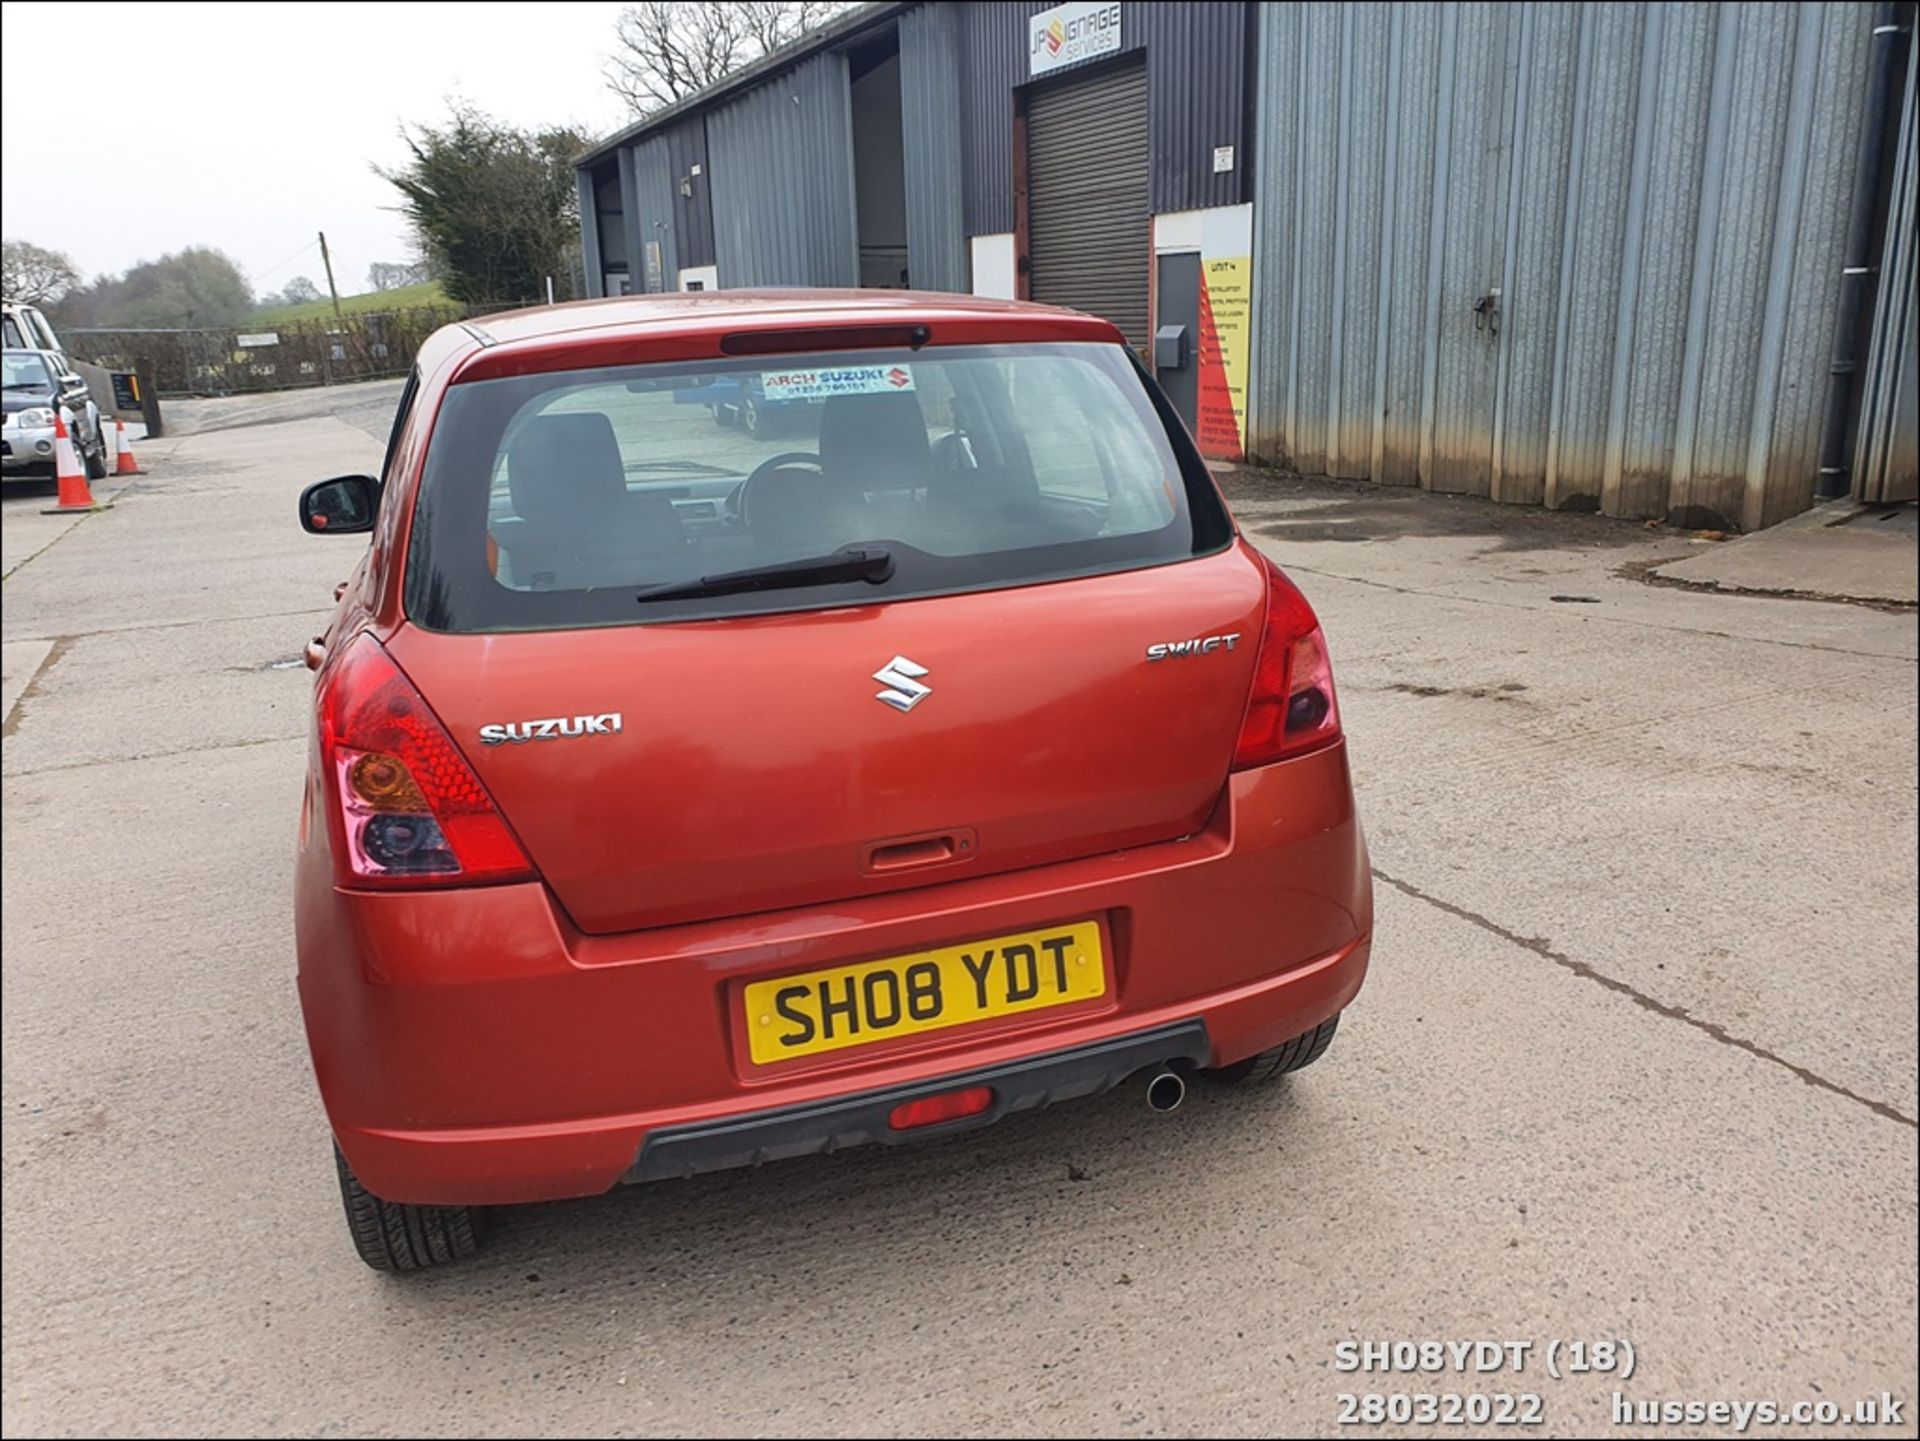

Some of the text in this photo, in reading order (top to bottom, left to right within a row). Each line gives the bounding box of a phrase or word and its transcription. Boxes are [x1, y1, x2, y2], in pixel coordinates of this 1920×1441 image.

[766, 370, 884, 386] ARCH SUZUKI
[1146, 633, 1240, 661] SWIFT
[479, 712, 622, 745] SUZUKI
[775, 936, 1075, 1046] SH08 YDT
